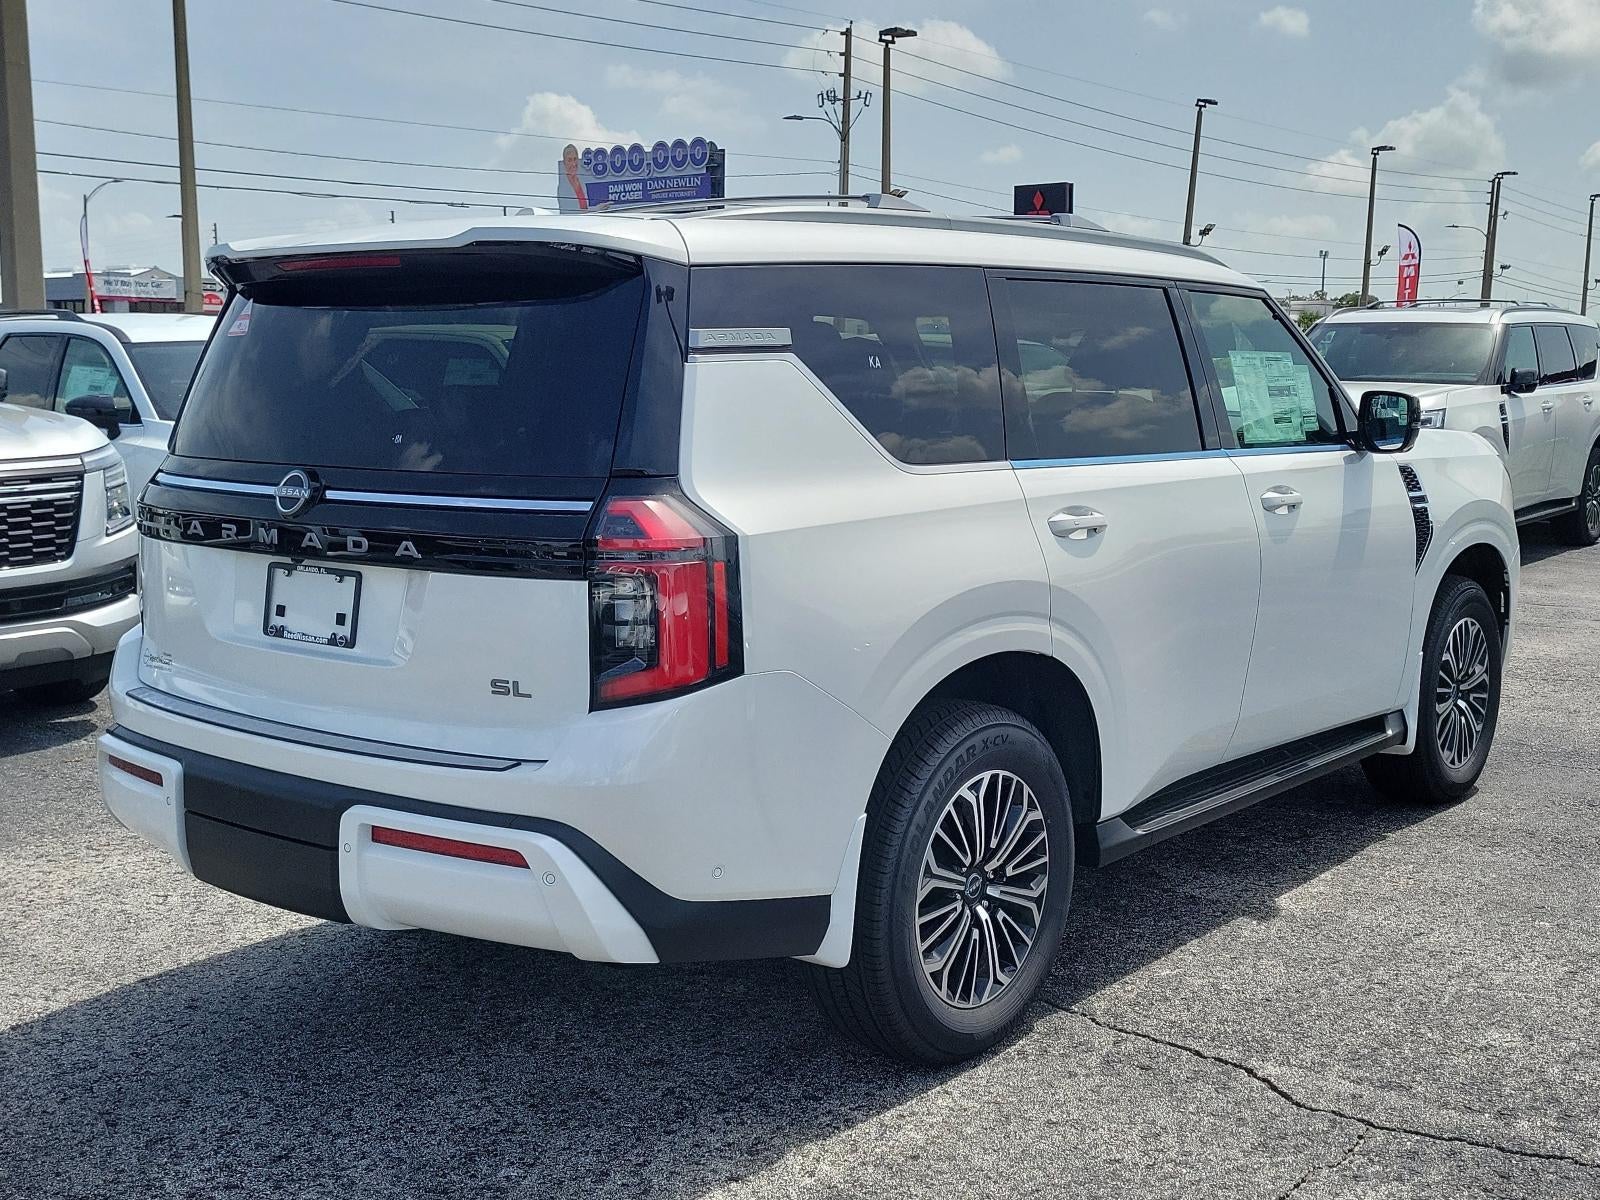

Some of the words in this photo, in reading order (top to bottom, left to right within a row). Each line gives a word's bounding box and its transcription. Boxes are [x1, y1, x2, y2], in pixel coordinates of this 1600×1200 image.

[582, 137, 709, 178] $800,000
[608, 184, 624, 194] DAN
[624, 182, 643, 192] WON
[647, 180, 665, 190] DAN
[665, 177, 701, 189] NEWLIN
[608, 193, 620, 201] MY
[134, 281, 149, 289] Your
[1402, 266, 1416, 304] MIT
[704, 332, 776, 343] ARMADA
[868, 355, 882, 369] KA
[274, 487, 310, 499] NISSAN
[187, 520, 422, 559] ARMADA
[490, 678, 533, 699] SL
